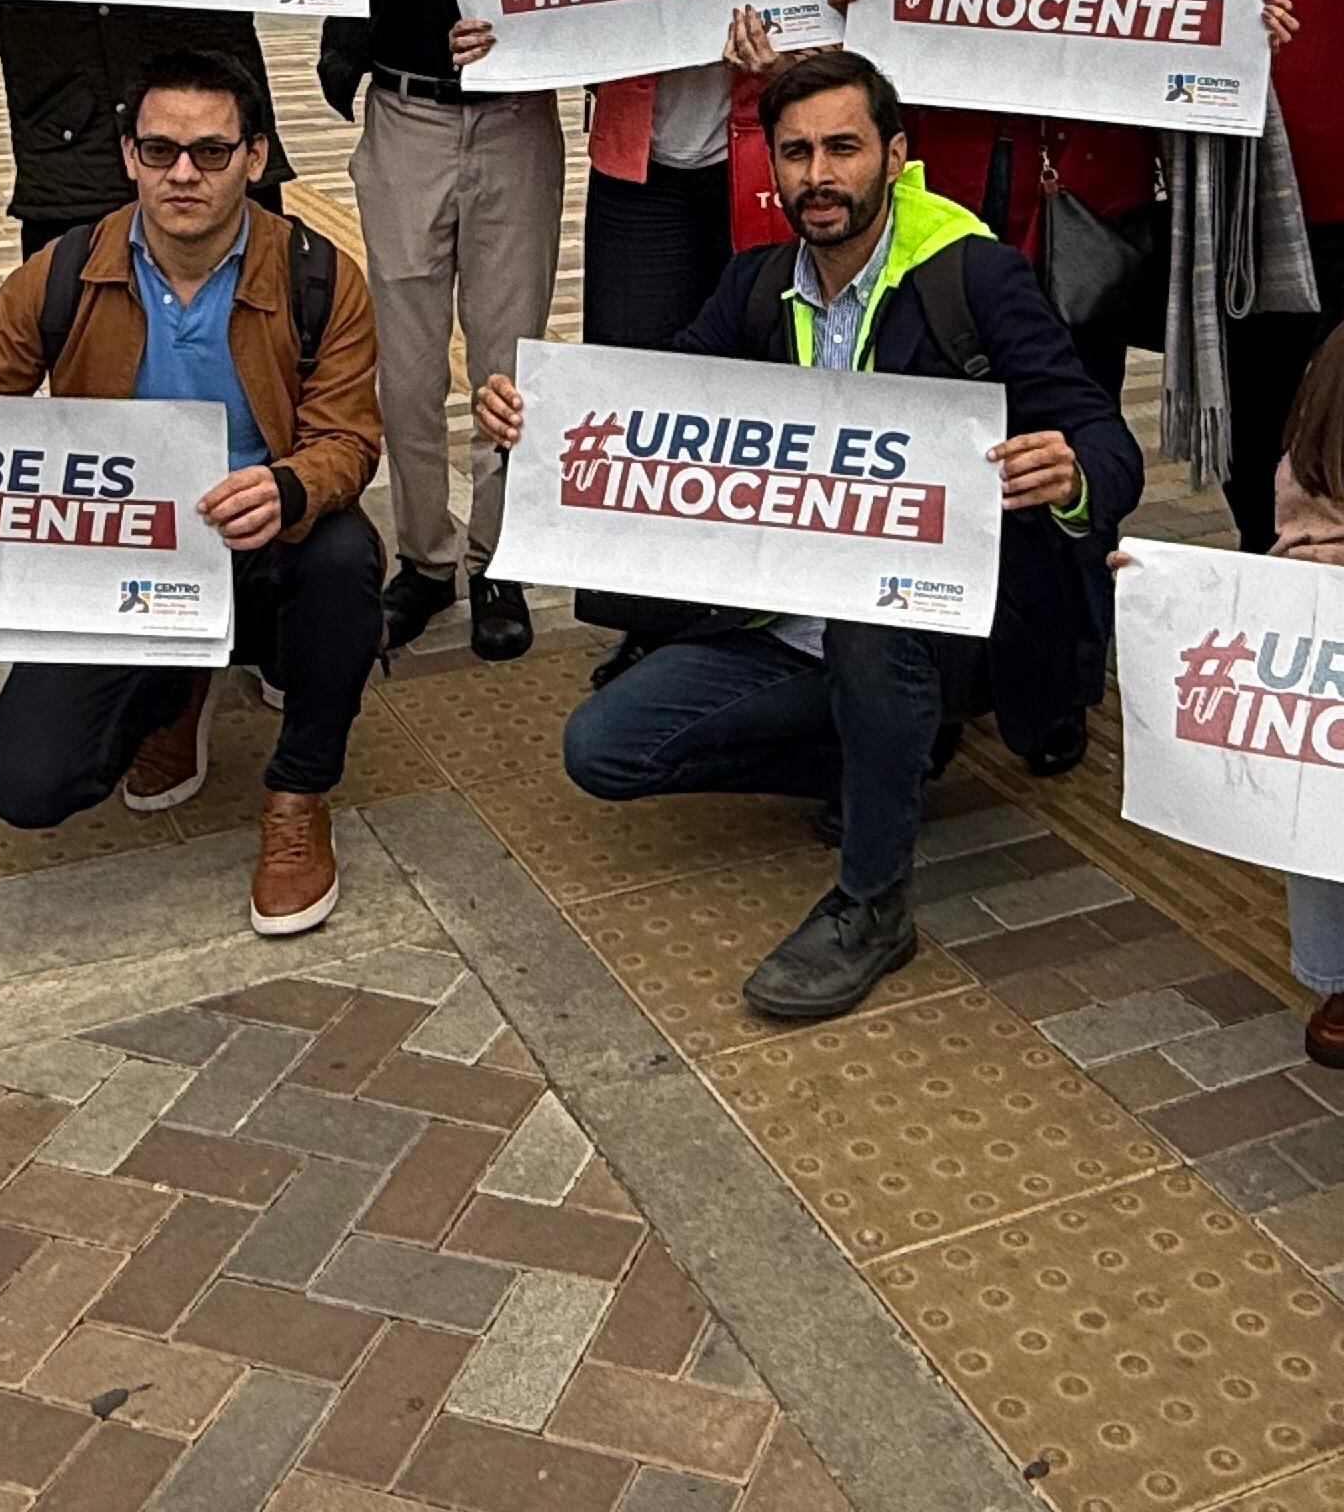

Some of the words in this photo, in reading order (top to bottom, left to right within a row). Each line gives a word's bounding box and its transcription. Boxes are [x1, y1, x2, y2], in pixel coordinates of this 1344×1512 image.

[62, 452, 137, 499] ES
[559, 410, 816, 487] #URIBE
[830, 428, 913, 480] ES
[601, 460, 927, 538] INOCENTE
